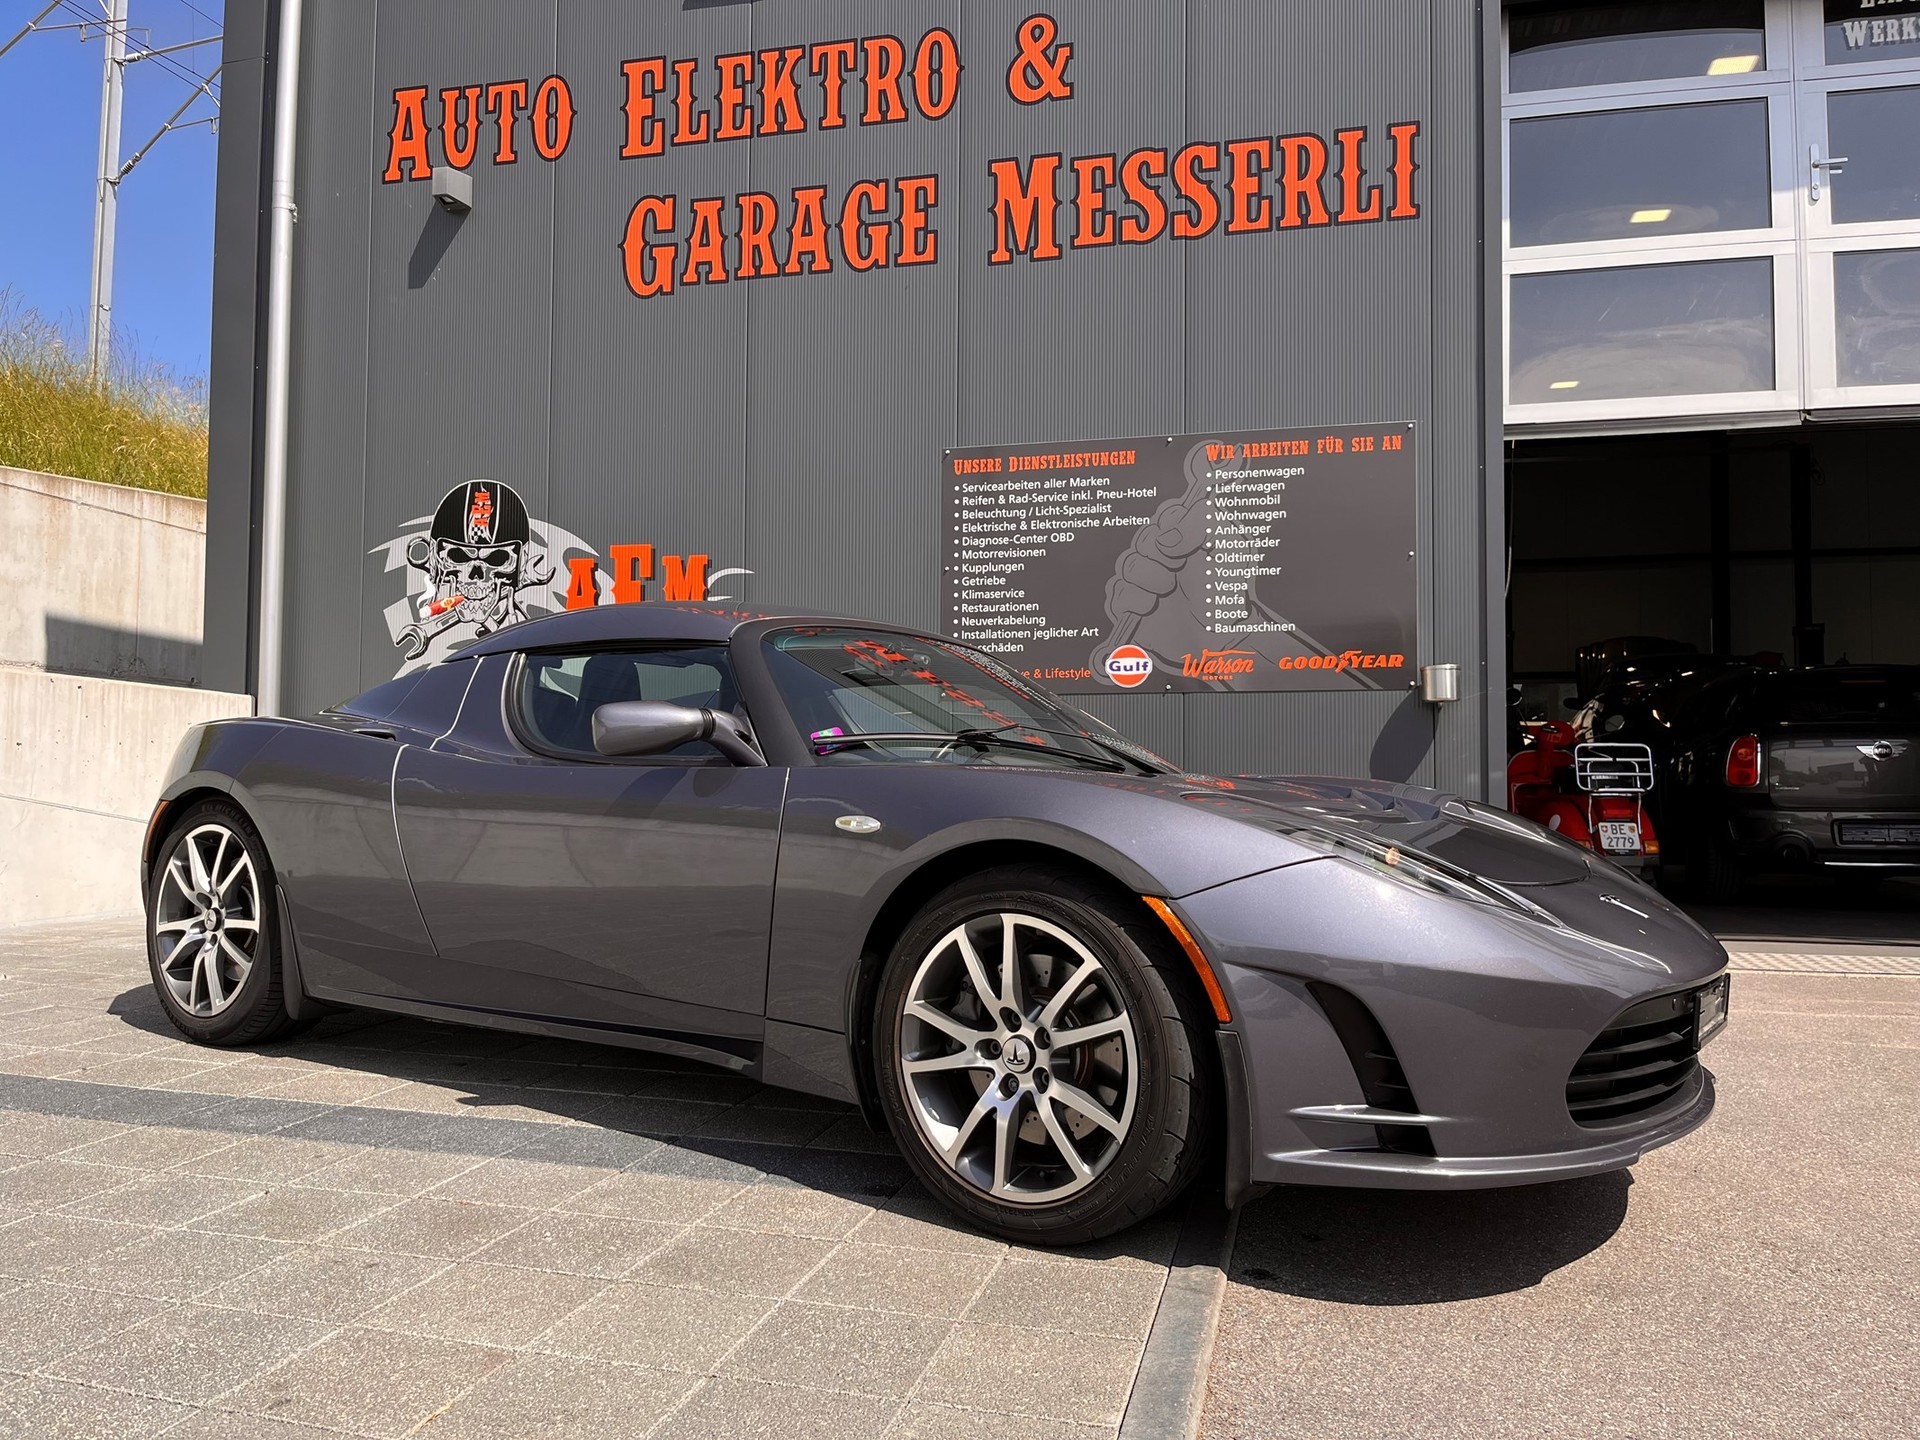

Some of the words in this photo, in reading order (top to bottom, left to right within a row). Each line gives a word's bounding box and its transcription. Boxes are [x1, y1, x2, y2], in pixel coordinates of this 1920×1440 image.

[1843, 17, 1920, 47] WERK
[382, 74, 577, 183] AUTO
[619, 27, 963, 159] ELEKTRO
[1006, 13, 1075, 105] &
[619, 173, 938, 299] GARAGE
[988, 120, 1420, 266] MESSERLI
[1206, 444, 1235, 462] WIR
[1242, 440, 1309, 458] ARBEITEN
[1317, 436, 1344, 454] FÜR
[1352, 436, 1374, 452] SIE
[1382, 435, 1402, 451] AN
[954, 458, 1002, 475] UNSERE
[1009, 450, 1136, 473] DIENSTLEISTUNGEN
[1215, 466, 1305, 480] Personenwagen
[962, 480, 1041, 493] Servicearbeiten
[1044, 478, 1067, 488] aller
[1070, 476, 1110, 487] Marken
[1215, 481, 1285, 494] Lieferwagen
[962, 494, 996, 506] Reifen
[997, 494, 1006, 504] &
[1008, 492, 1069, 504] Rad-Service
[1071, 490, 1094, 501] inkl.
[1096, 487, 1157, 499] Pneu-Hotel
[1215, 494, 1281, 508] Wohnmobil
[962, 507, 1027, 520] Beleuchtung
[1028, 505, 1033, 517] /
[1035, 504, 1112, 518] Licht-Spezialist
[1215, 509, 1287, 522] Wohnwagen
[962, 521, 1017, 533] Elektrische
[1019, 521, 1028, 530] &
[1030, 517, 1100, 530] Elektronische
[1102, 516, 1150, 527] Arbeiten
[1215, 523, 1272, 536] Anhänger
[962, 534, 1048, 548] Diagnose-Center
[1050, 532, 1075, 543] OBD
[1215, 537, 1280, 549] Motorräder
[962, 548, 1046, 560] Motorrevisionen
[1215, 552, 1265, 564] Oldtimer
[962, 562, 1025, 574] Kupplungen
[1215, 566, 1282, 578] Youngtimer
[962, 575, 1006, 586] Getriebe
[1215, 581, 1248, 593] Vespa
[962, 588, 1025, 600] Klimaservice
[1215, 595, 1245, 606] Mofa
[962, 602, 1039, 613] Restaurationen
[1215, 609, 1248, 619] Boote
[962, 614, 1046, 627] Neuverkabelung
[962, 628, 1031, 640] Installationen
[1033, 627, 1079, 641] jeglicher
[1081, 626, 1099, 637] Art
[1215, 622, 1296, 634] Baumaschinen
[1108, 660, 1149, 673] Gulf
[1181, 649, 1256, 678] Warson
[1279, 651, 1405, 672] GOODYEAR
[1034, 669, 1042, 679] &
[1045, 668, 1091, 680] Lifestyle
[1610, 824, 1626, 835] BE
[1606, 836, 1635, 848] 2779
